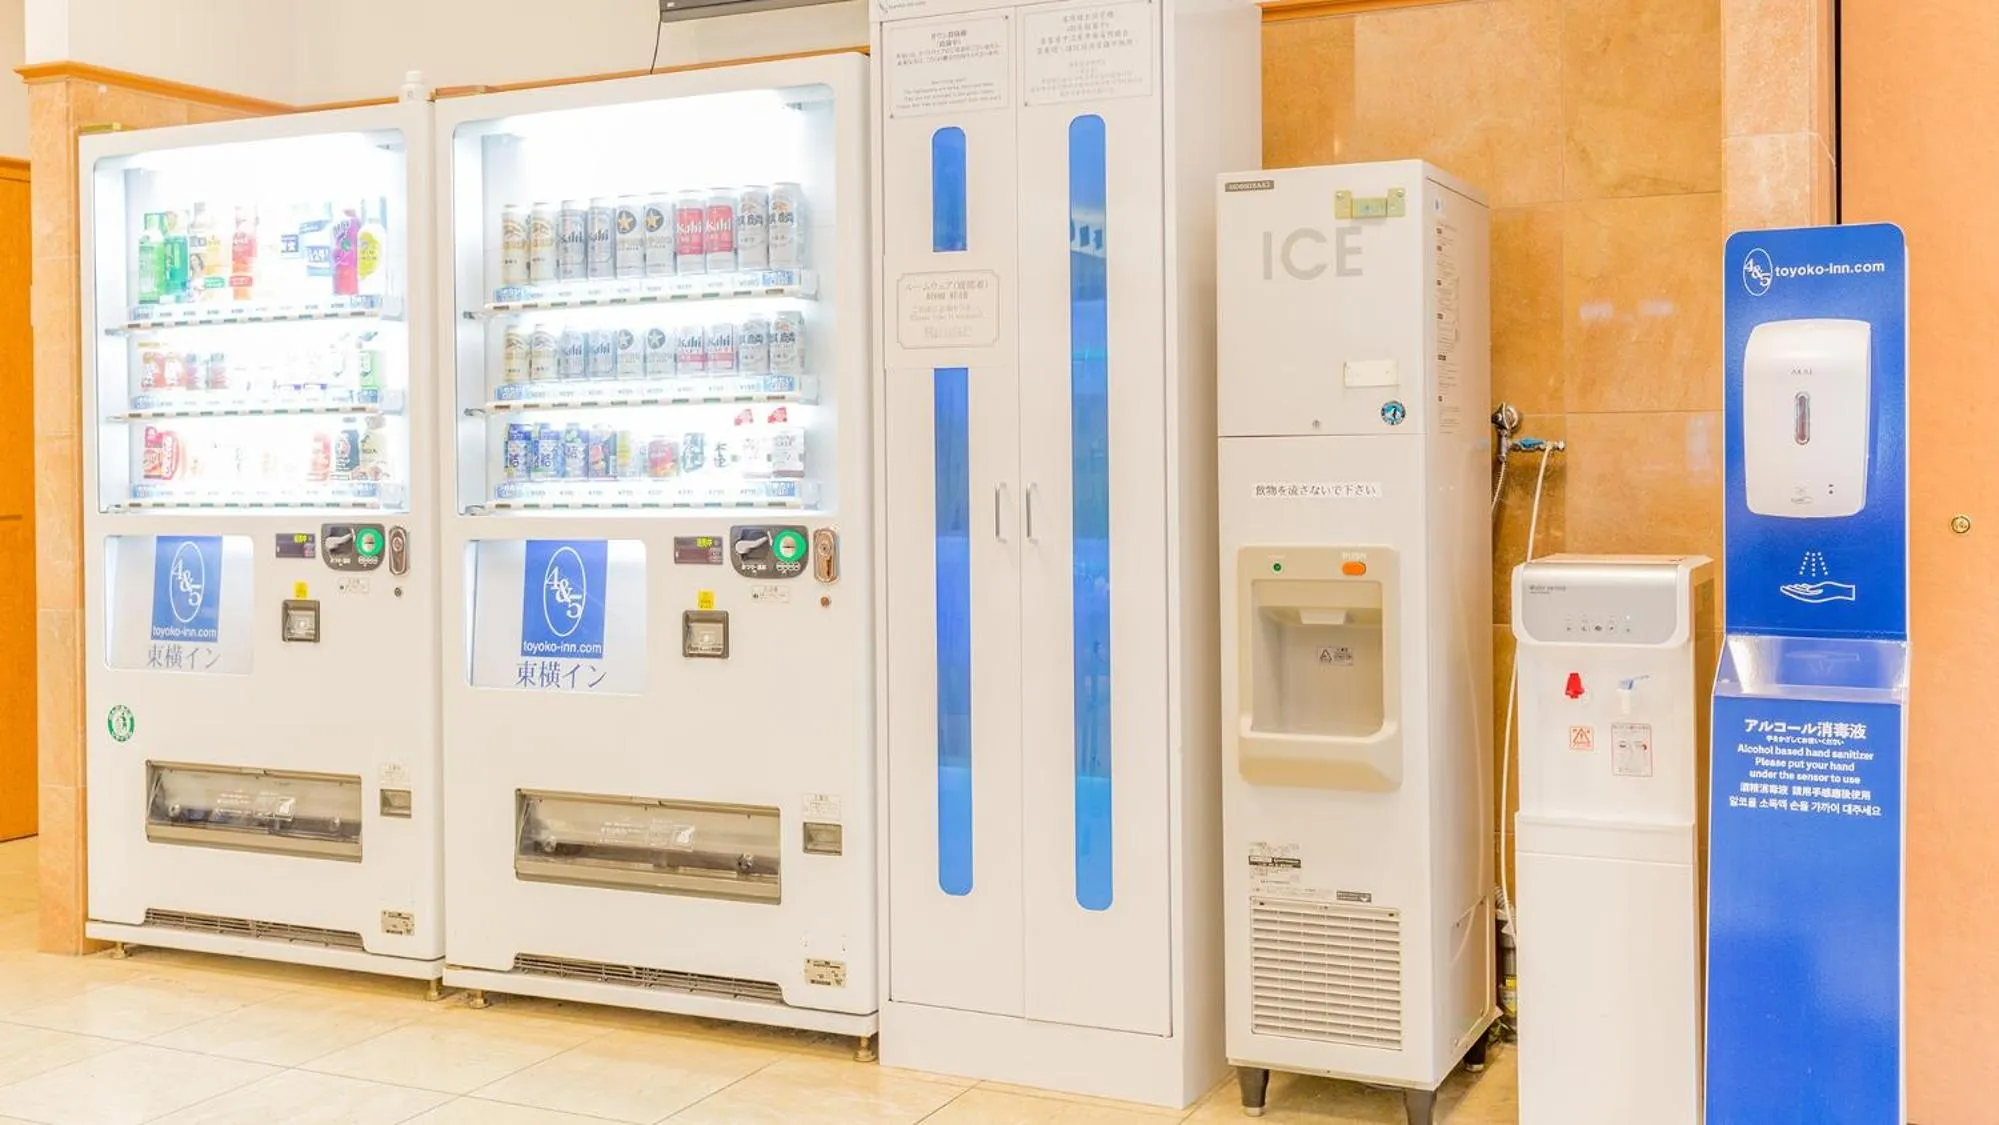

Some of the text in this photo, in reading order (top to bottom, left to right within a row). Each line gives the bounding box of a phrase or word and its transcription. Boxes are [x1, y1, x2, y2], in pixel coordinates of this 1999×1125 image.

[1263, 226, 1363, 281] ICE
[1775, 262, 1885, 278] toyoko-inn.com
[153, 625, 217, 638] toyoko-inn.com
[523, 640, 602, 655] toyoko-inn.com
[147, 644, 221, 669] 東横イン
[515, 661, 607, 689] 東横イン
[1744, 719, 1867, 739] アルコール消毒液
[1738, 744, 1874, 760] Alcohol based hand sanitizer
[1755, 757, 1854, 772] Please put your hand
[1749, 769, 1861, 784] under the sensor to use
[1811, 802, 1840, 814] 가까이
